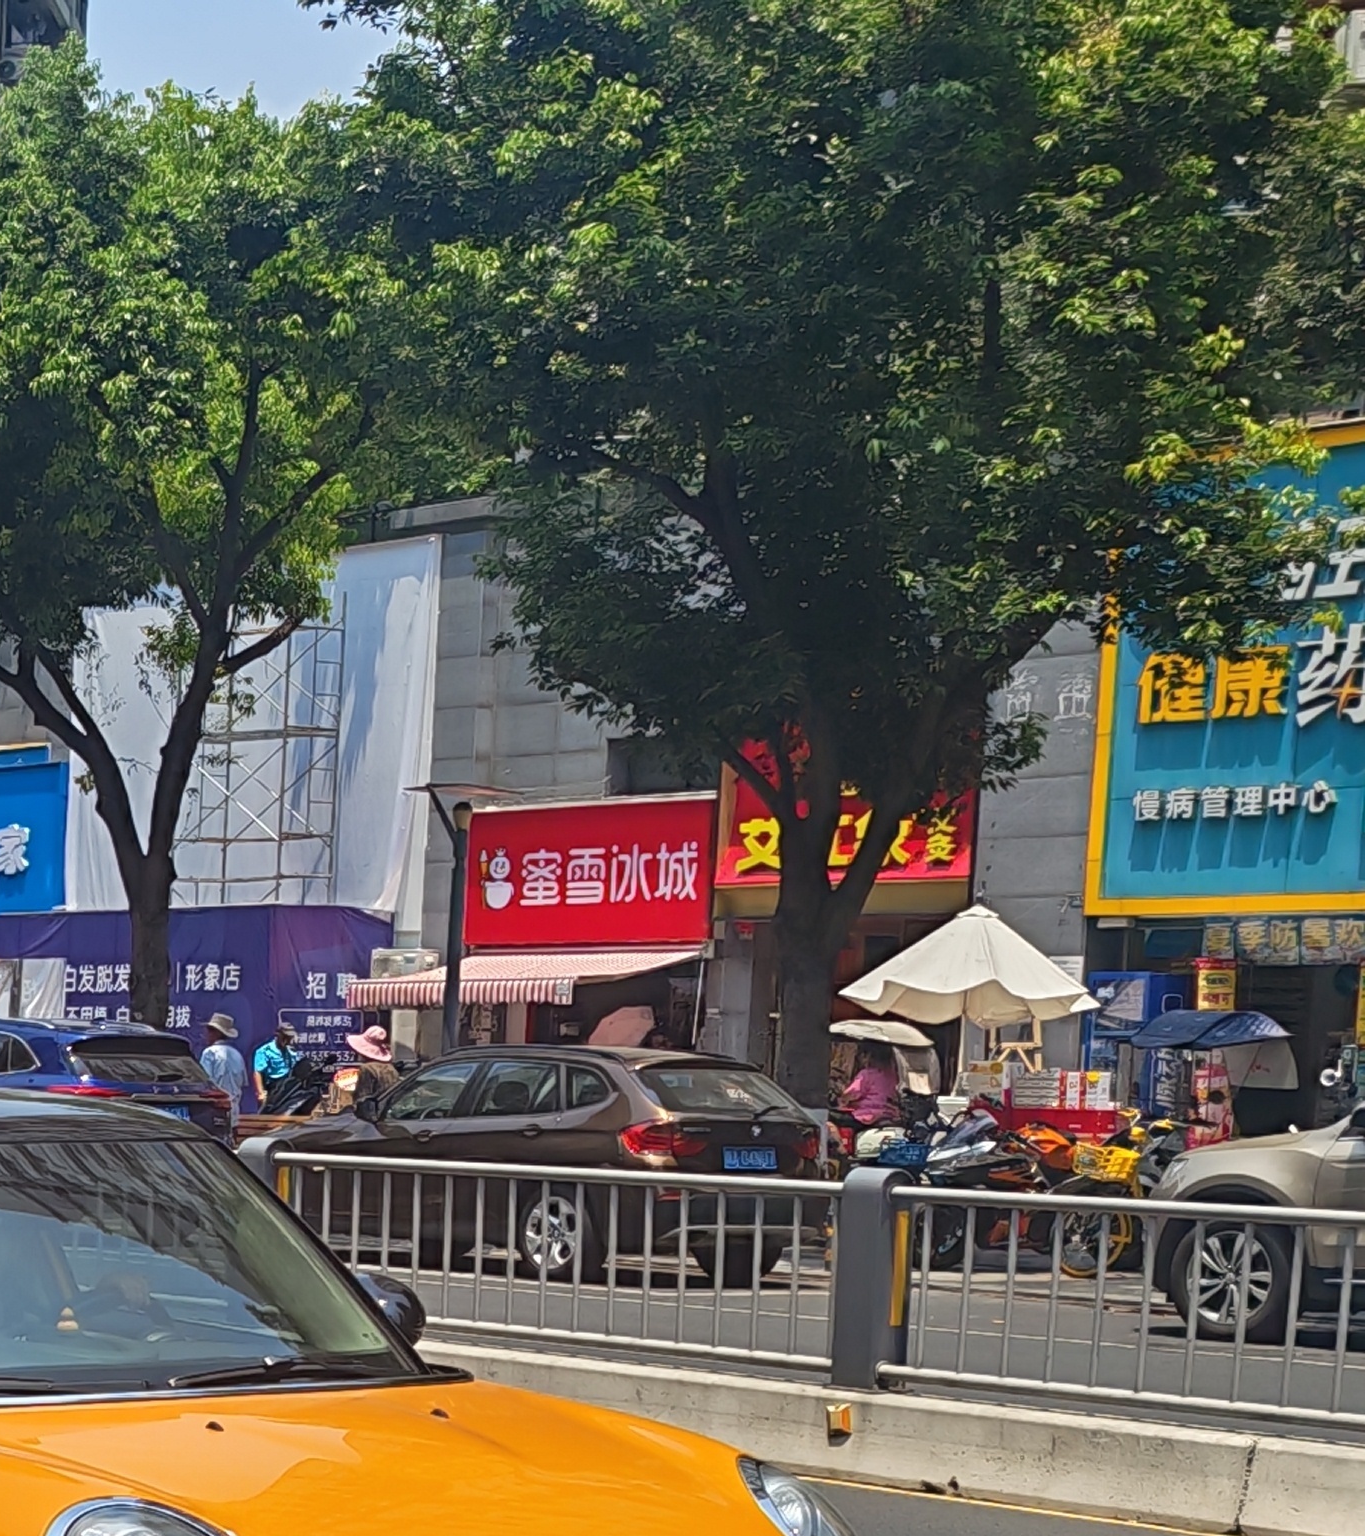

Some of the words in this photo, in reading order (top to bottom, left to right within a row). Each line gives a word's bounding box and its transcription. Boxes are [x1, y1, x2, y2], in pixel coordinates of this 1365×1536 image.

[1132, 779, 1338, 822] 慢病管理中心
[519, 841, 699, 906] 蜜雪冰城
[185, 963, 241, 991] 形象店
